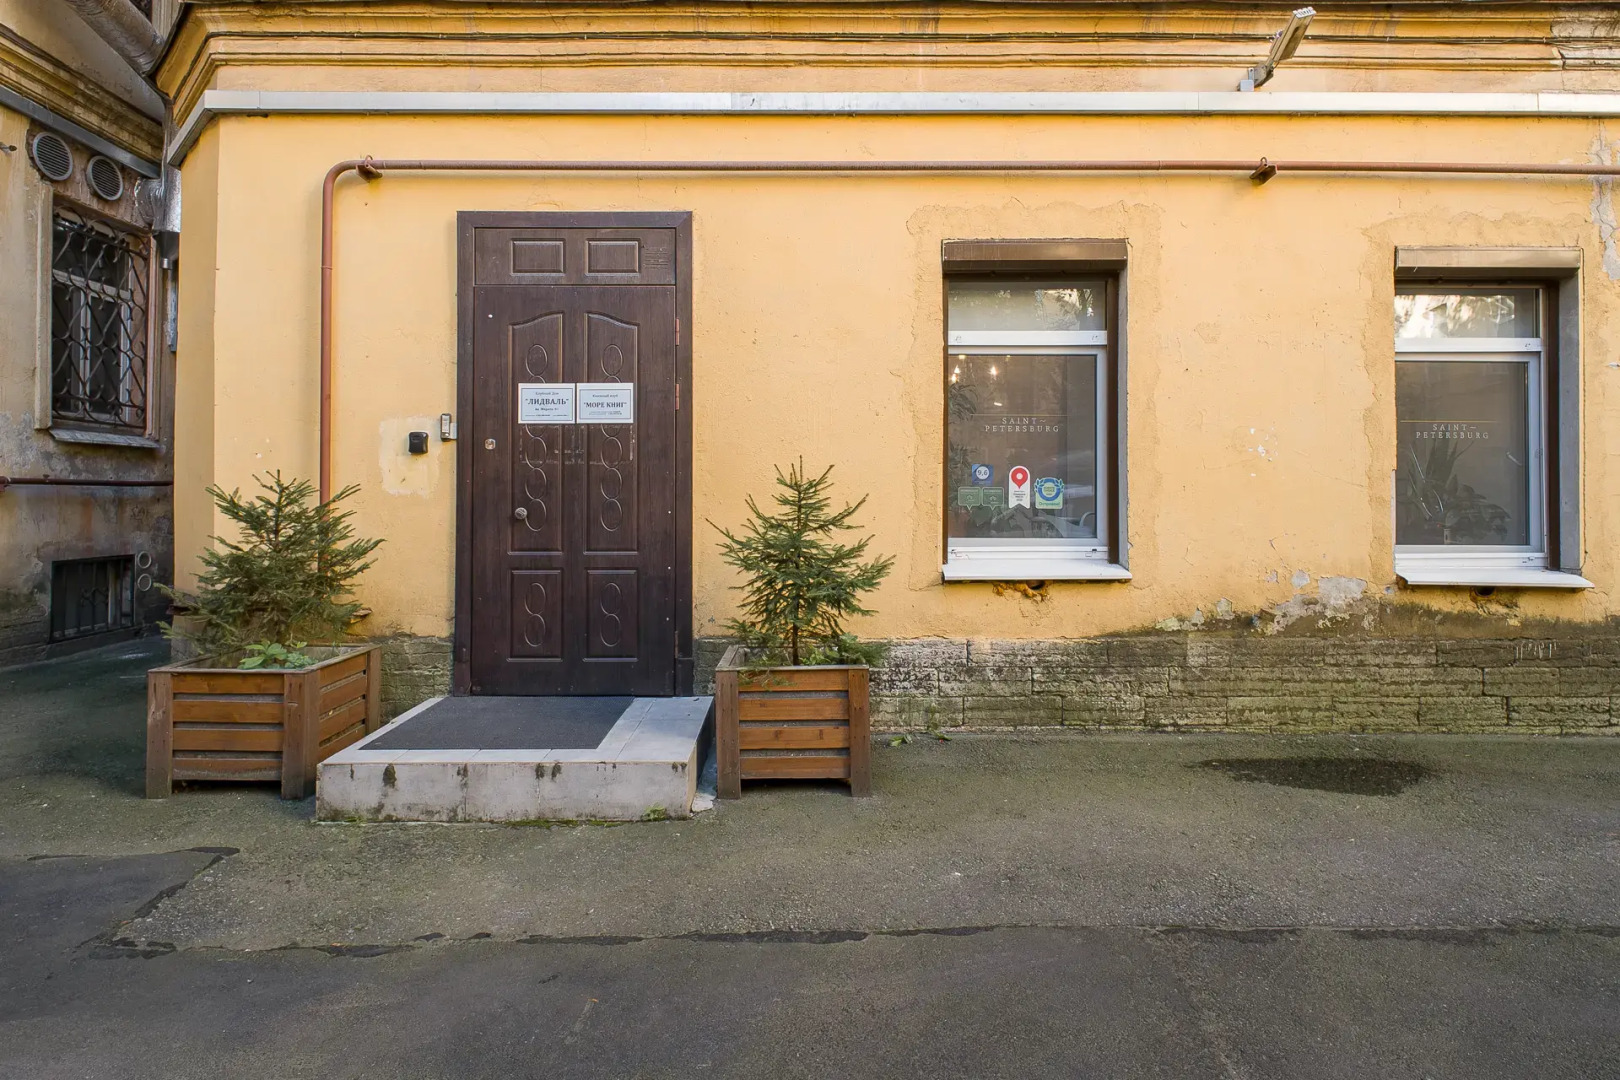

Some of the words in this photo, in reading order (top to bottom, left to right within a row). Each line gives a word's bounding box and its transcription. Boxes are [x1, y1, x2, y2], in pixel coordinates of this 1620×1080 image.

[525, 398, 569, 406] "ЛИДВАЛЬ"
[985, 425, 1059, 433] PETERSBURG
[1416, 431, 1489, 439] PETERSBURG
[977, 469, 988, 477] 9,6
